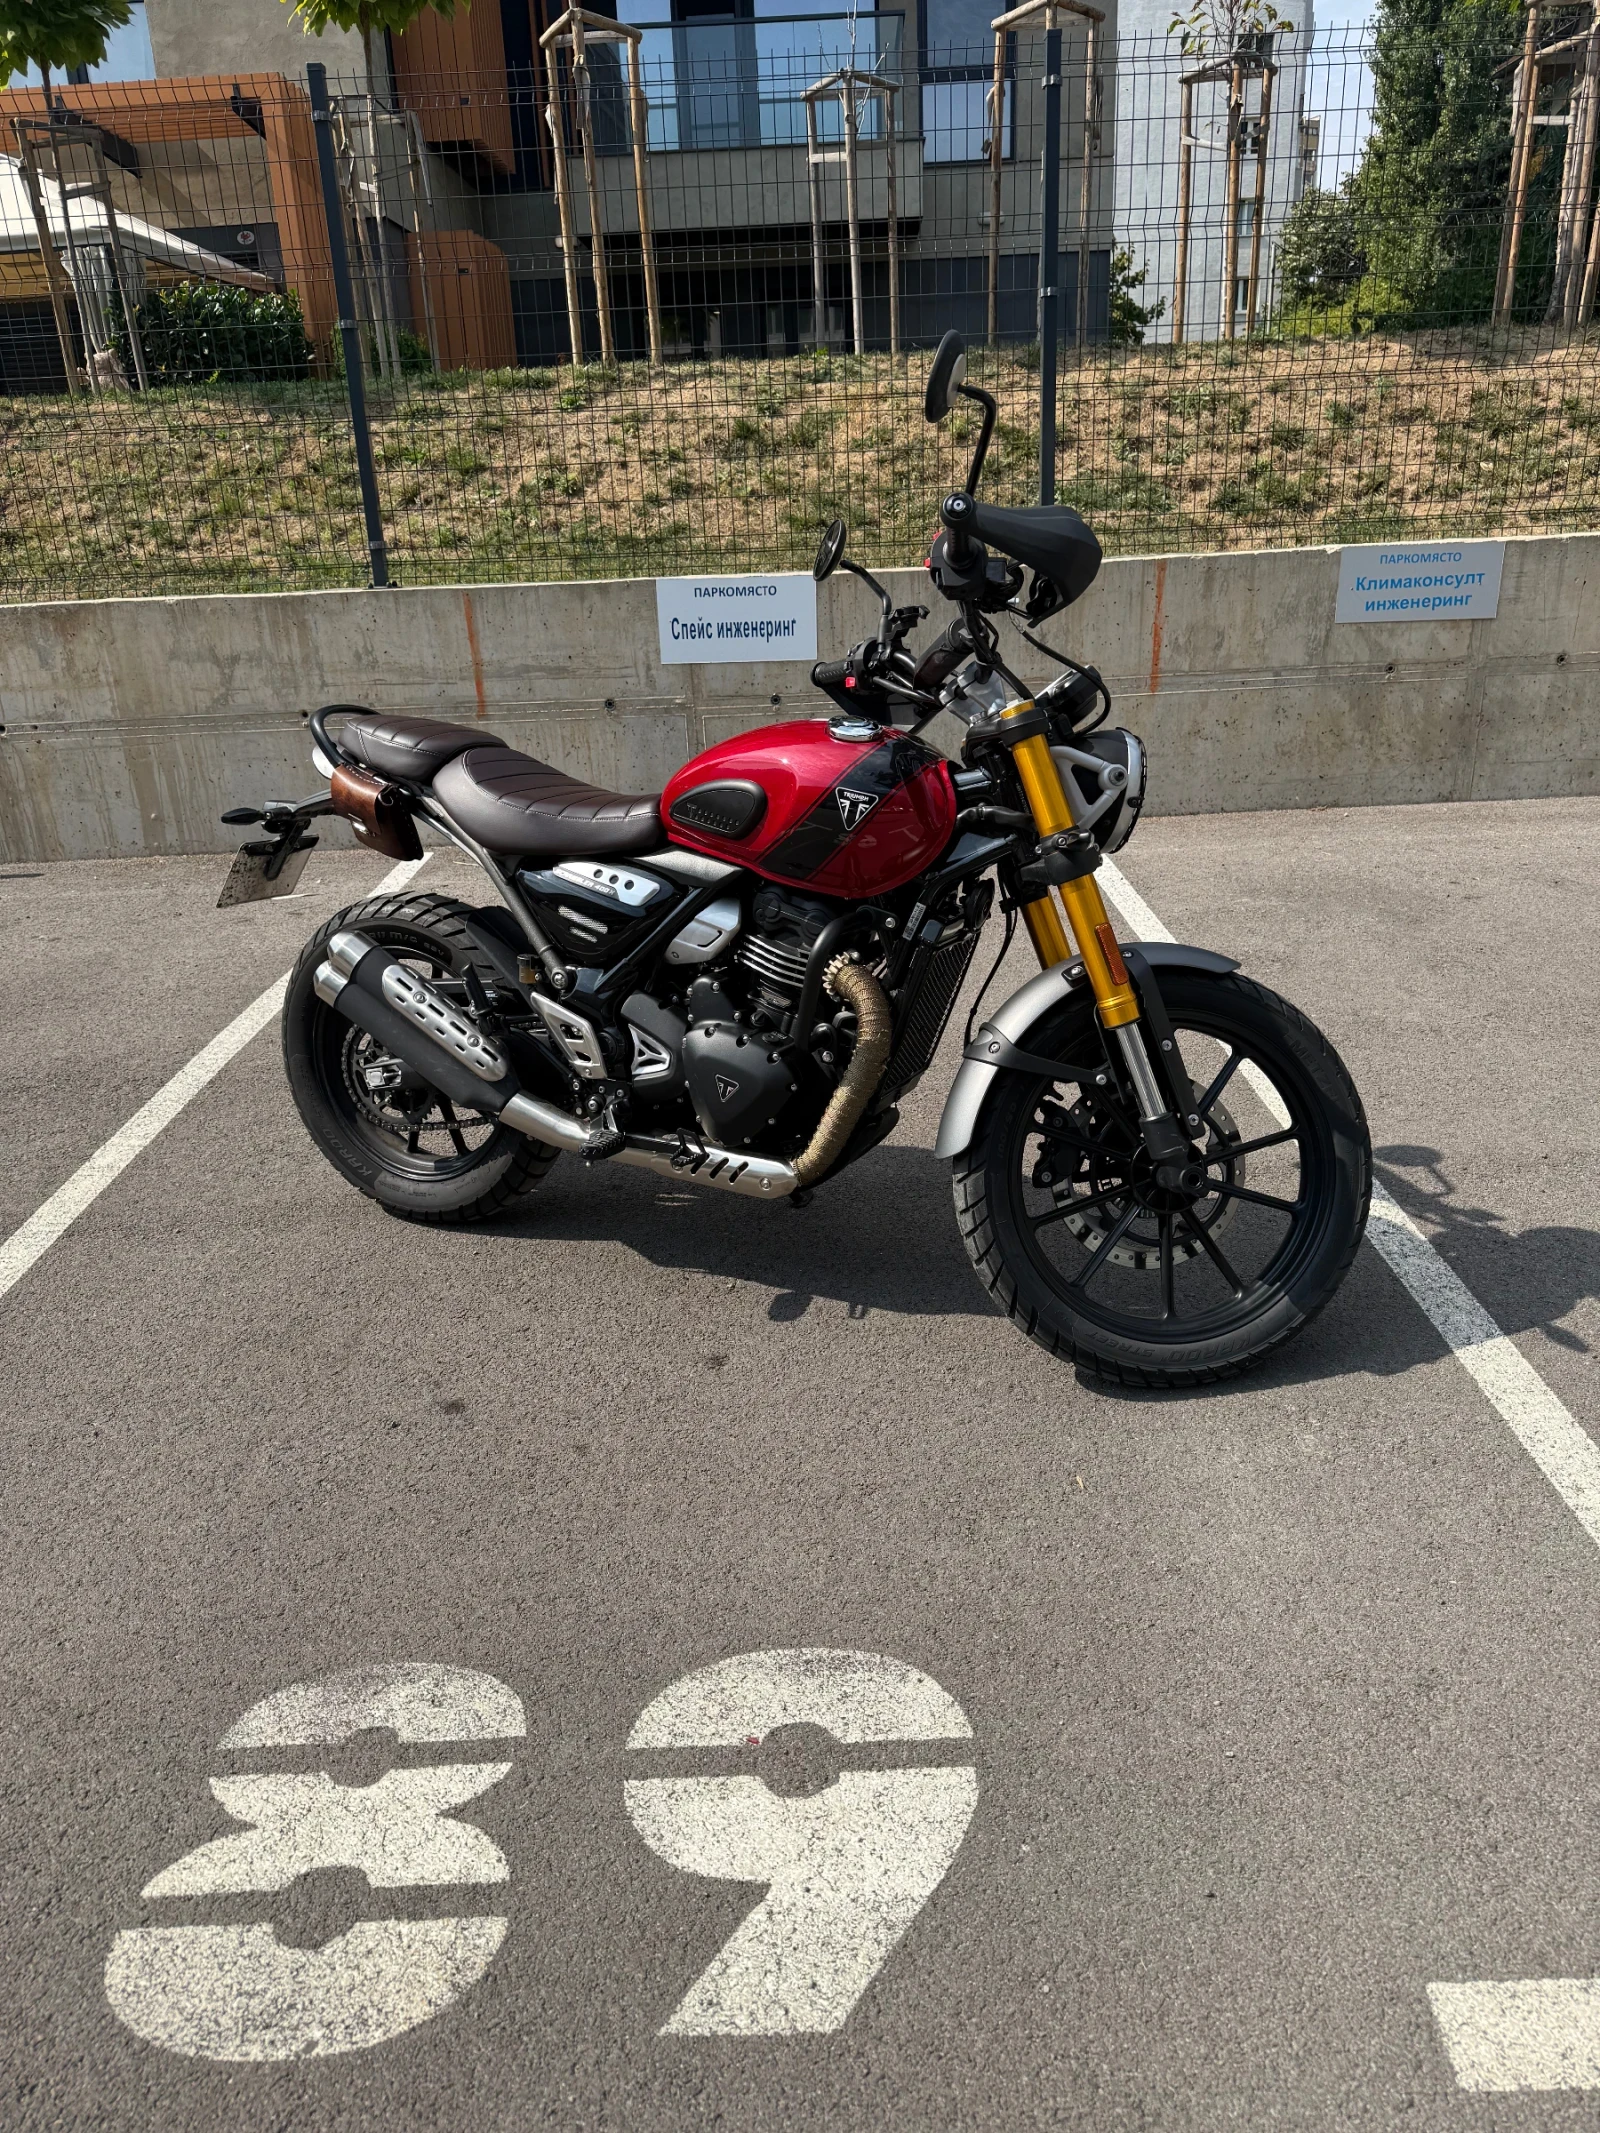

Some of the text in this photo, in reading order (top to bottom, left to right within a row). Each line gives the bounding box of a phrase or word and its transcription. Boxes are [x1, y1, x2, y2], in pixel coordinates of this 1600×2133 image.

[1380, 552, 1462, 564] ПАРКОМЯСТО
[694, 585, 777, 597] ПАРКОМЯСТО
[1355, 572, 1485, 591] Климаконсулт
[1365, 594, 1472, 612] инженеринг
[671, 617, 796, 643] Спейс инженеринг
[844, 791, 869, 802] TRIUMPH
[322, 1129, 373, 1177] KAROO
[1084, 1332, 1156, 1358] STREET
[103, 1647, 979, 2062] 89
